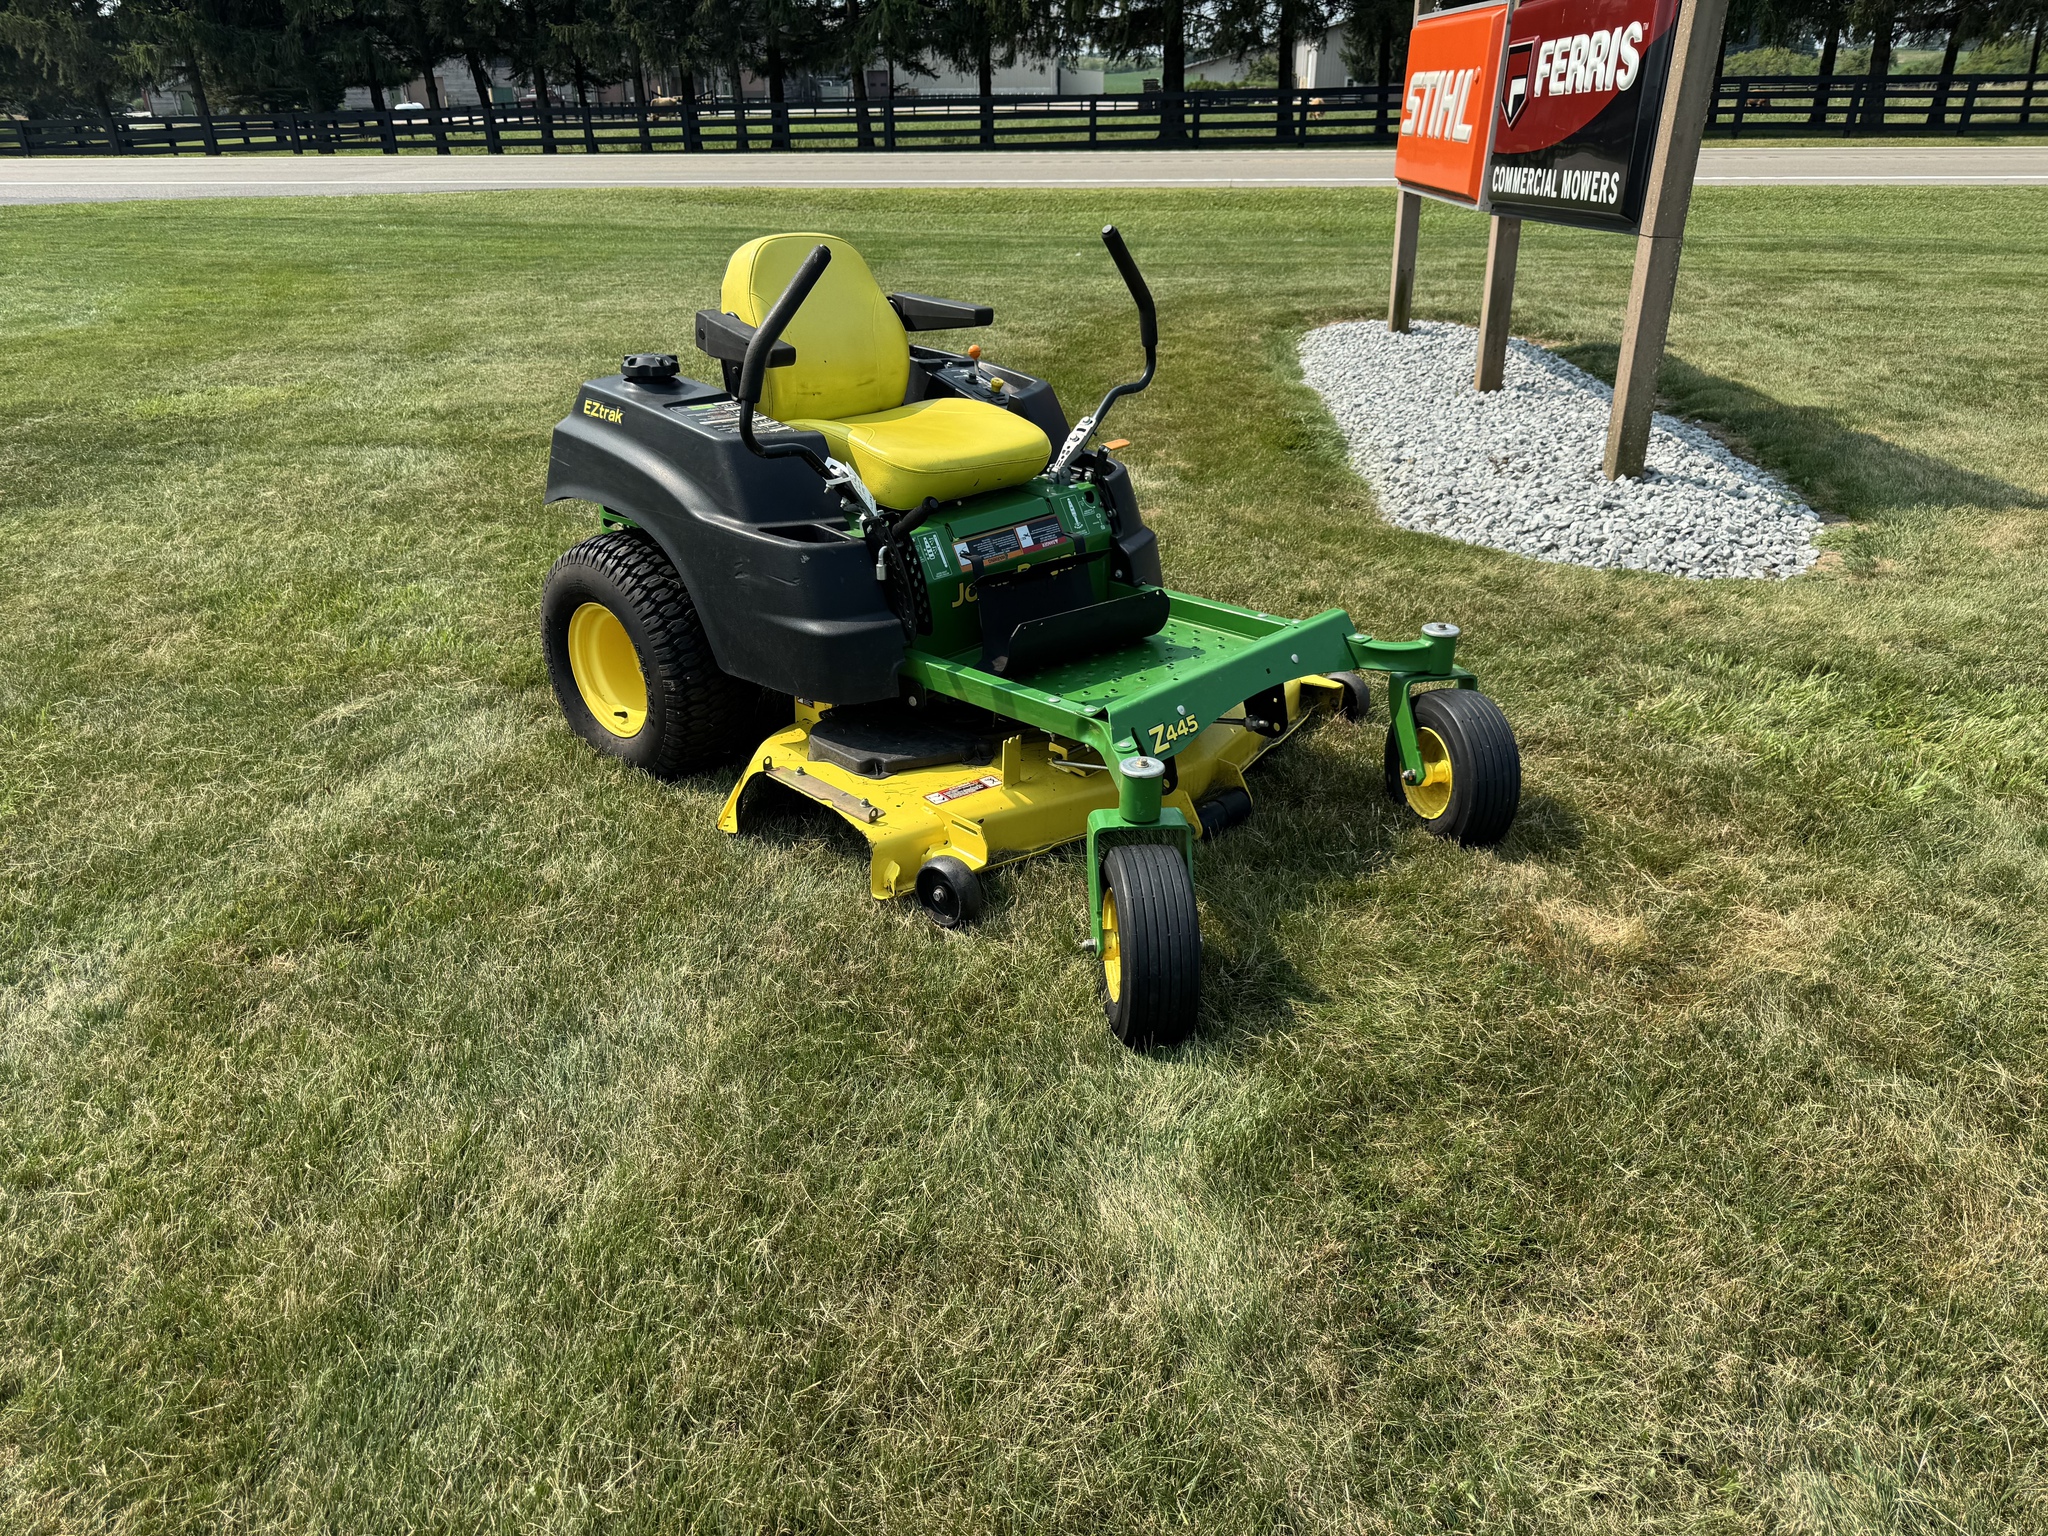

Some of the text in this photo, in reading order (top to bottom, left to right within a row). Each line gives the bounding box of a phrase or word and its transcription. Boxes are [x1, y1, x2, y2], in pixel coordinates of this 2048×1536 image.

[1534, 21, 1643, 98] FERRIS
[1401, 69, 1475, 143] STIHL
[1492, 166, 1621, 205] COMMERCIAL MOWERS
[583, 399, 624, 425] EZtrak
[1148, 714, 1199, 756] Z445
